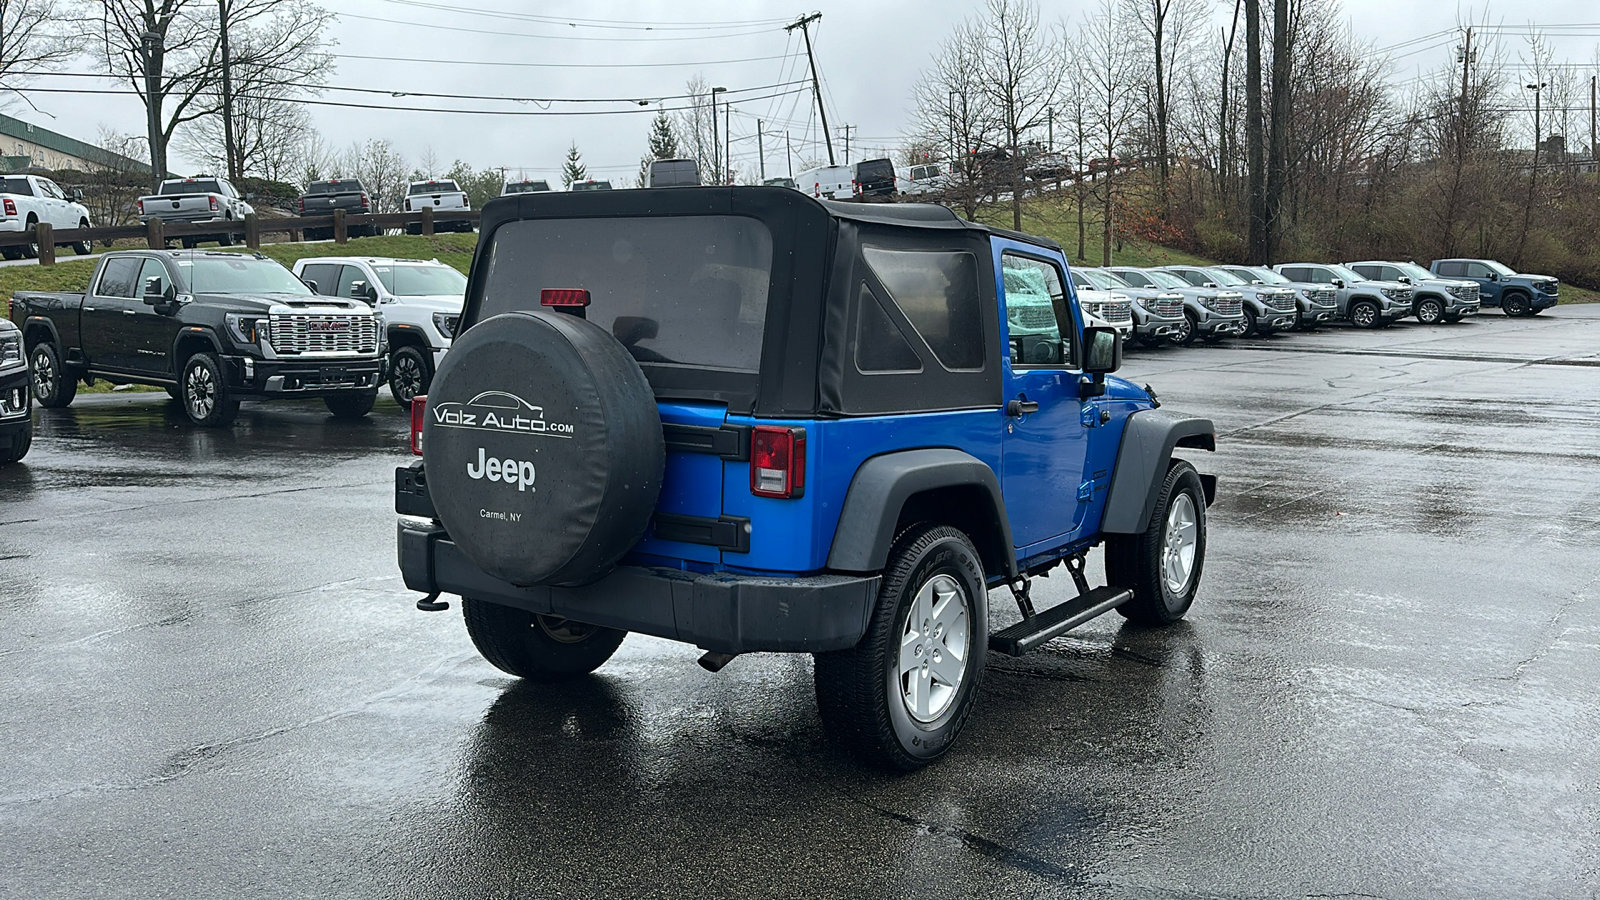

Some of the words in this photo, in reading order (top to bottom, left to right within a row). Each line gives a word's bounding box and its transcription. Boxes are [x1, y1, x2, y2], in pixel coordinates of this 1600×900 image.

[432, 407, 477, 426] Volz
[467, 447, 536, 492] Jeep
[479, 508, 508, 522] Carmel,
[509, 512, 522, 522] NY
